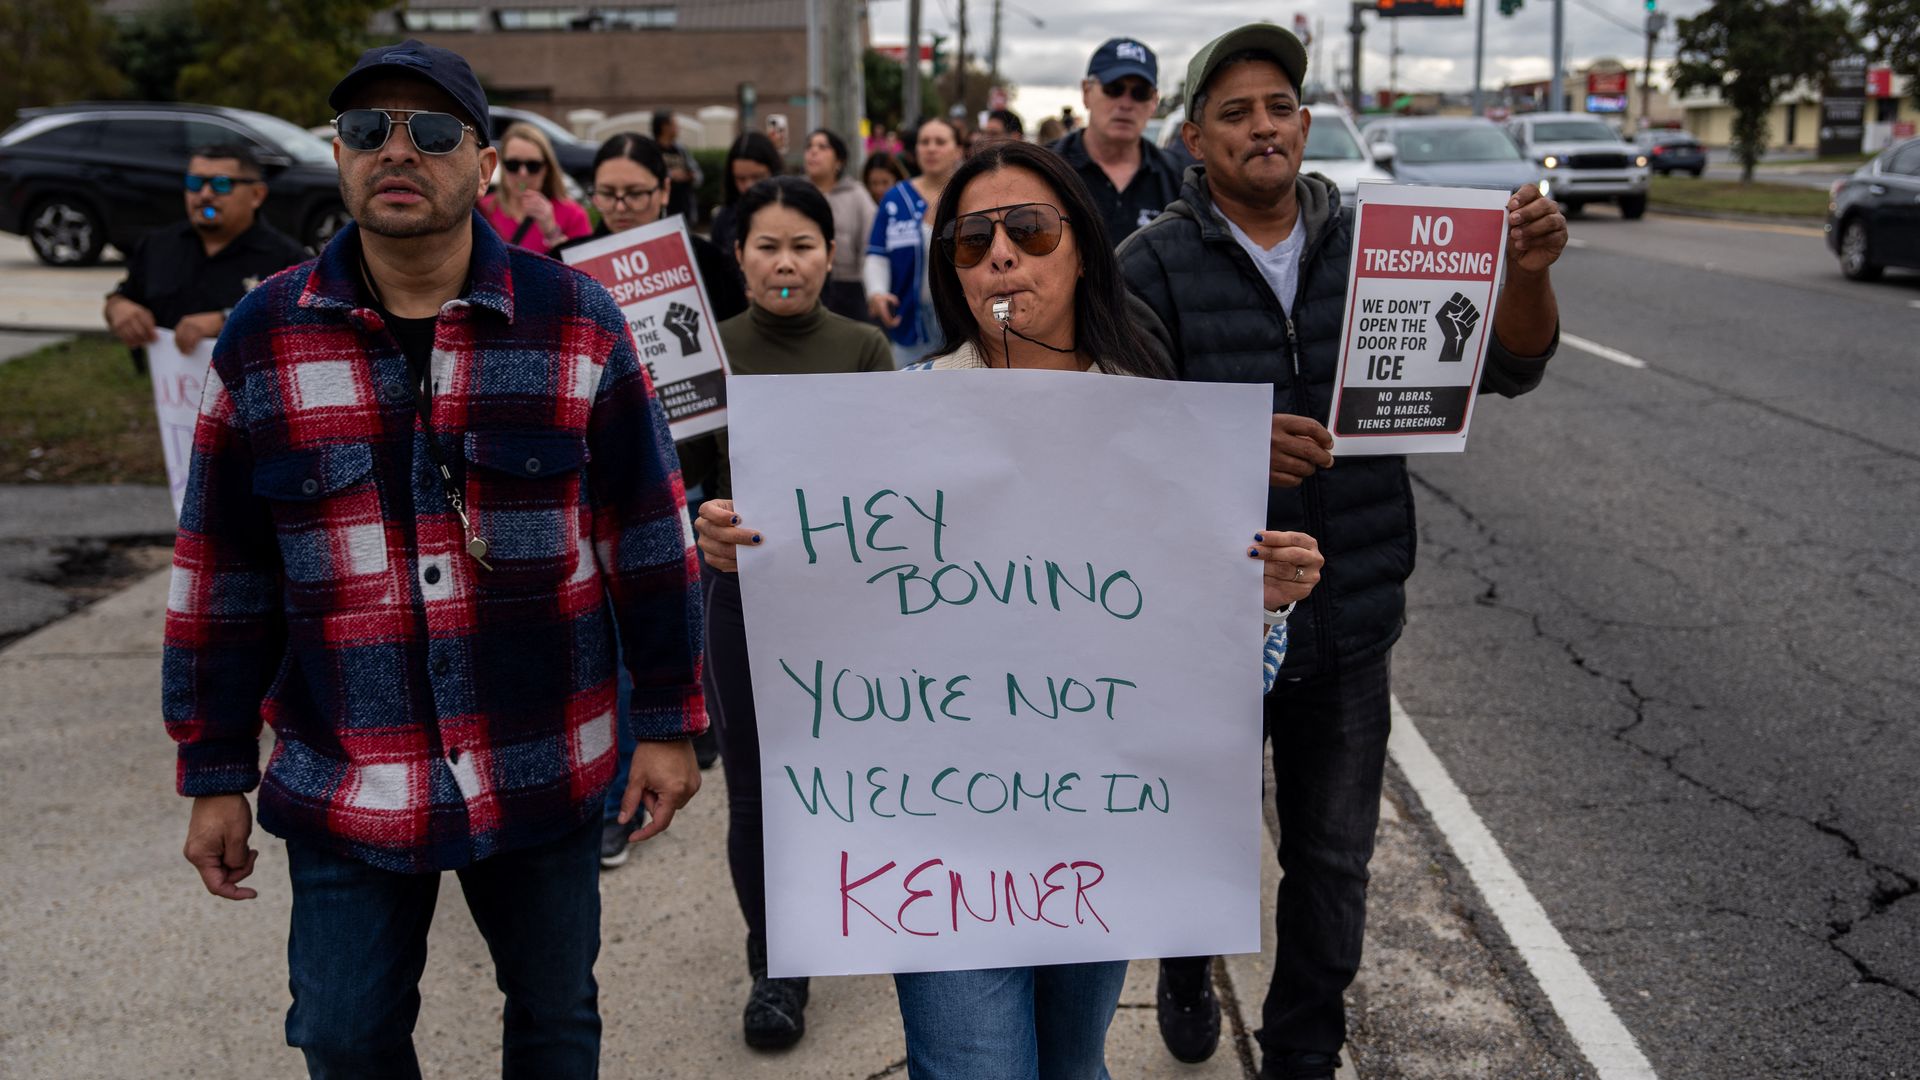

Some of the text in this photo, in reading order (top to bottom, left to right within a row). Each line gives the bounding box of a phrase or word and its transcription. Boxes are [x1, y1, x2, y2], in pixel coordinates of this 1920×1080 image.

[1411, 215, 1454, 247] NO
[611, 250, 649, 281] NO
[1364, 248, 1492, 275] TRESPASSING
[1362, 299, 1431, 314] WE DON'T
[630, 315, 655, 331] ON'T
[1359, 318, 1427, 333] OPEN THE
[638, 329, 660, 345] THE
[1357, 336, 1427, 351] DOOR FOR
[644, 342, 668, 359] FOR
[1367, 355, 1405, 381] ICE
[1378, 391, 1392, 402] NO
[1376, 405, 1391, 416] NO
[1357, 416, 1446, 429] TIENES DERECHOS!
[795, 488, 947, 564] HEY
[1006, 672, 1137, 720] NOT
[784, 765, 1169, 823] WELCOME IN
[840, 850, 1110, 937] KENNER
